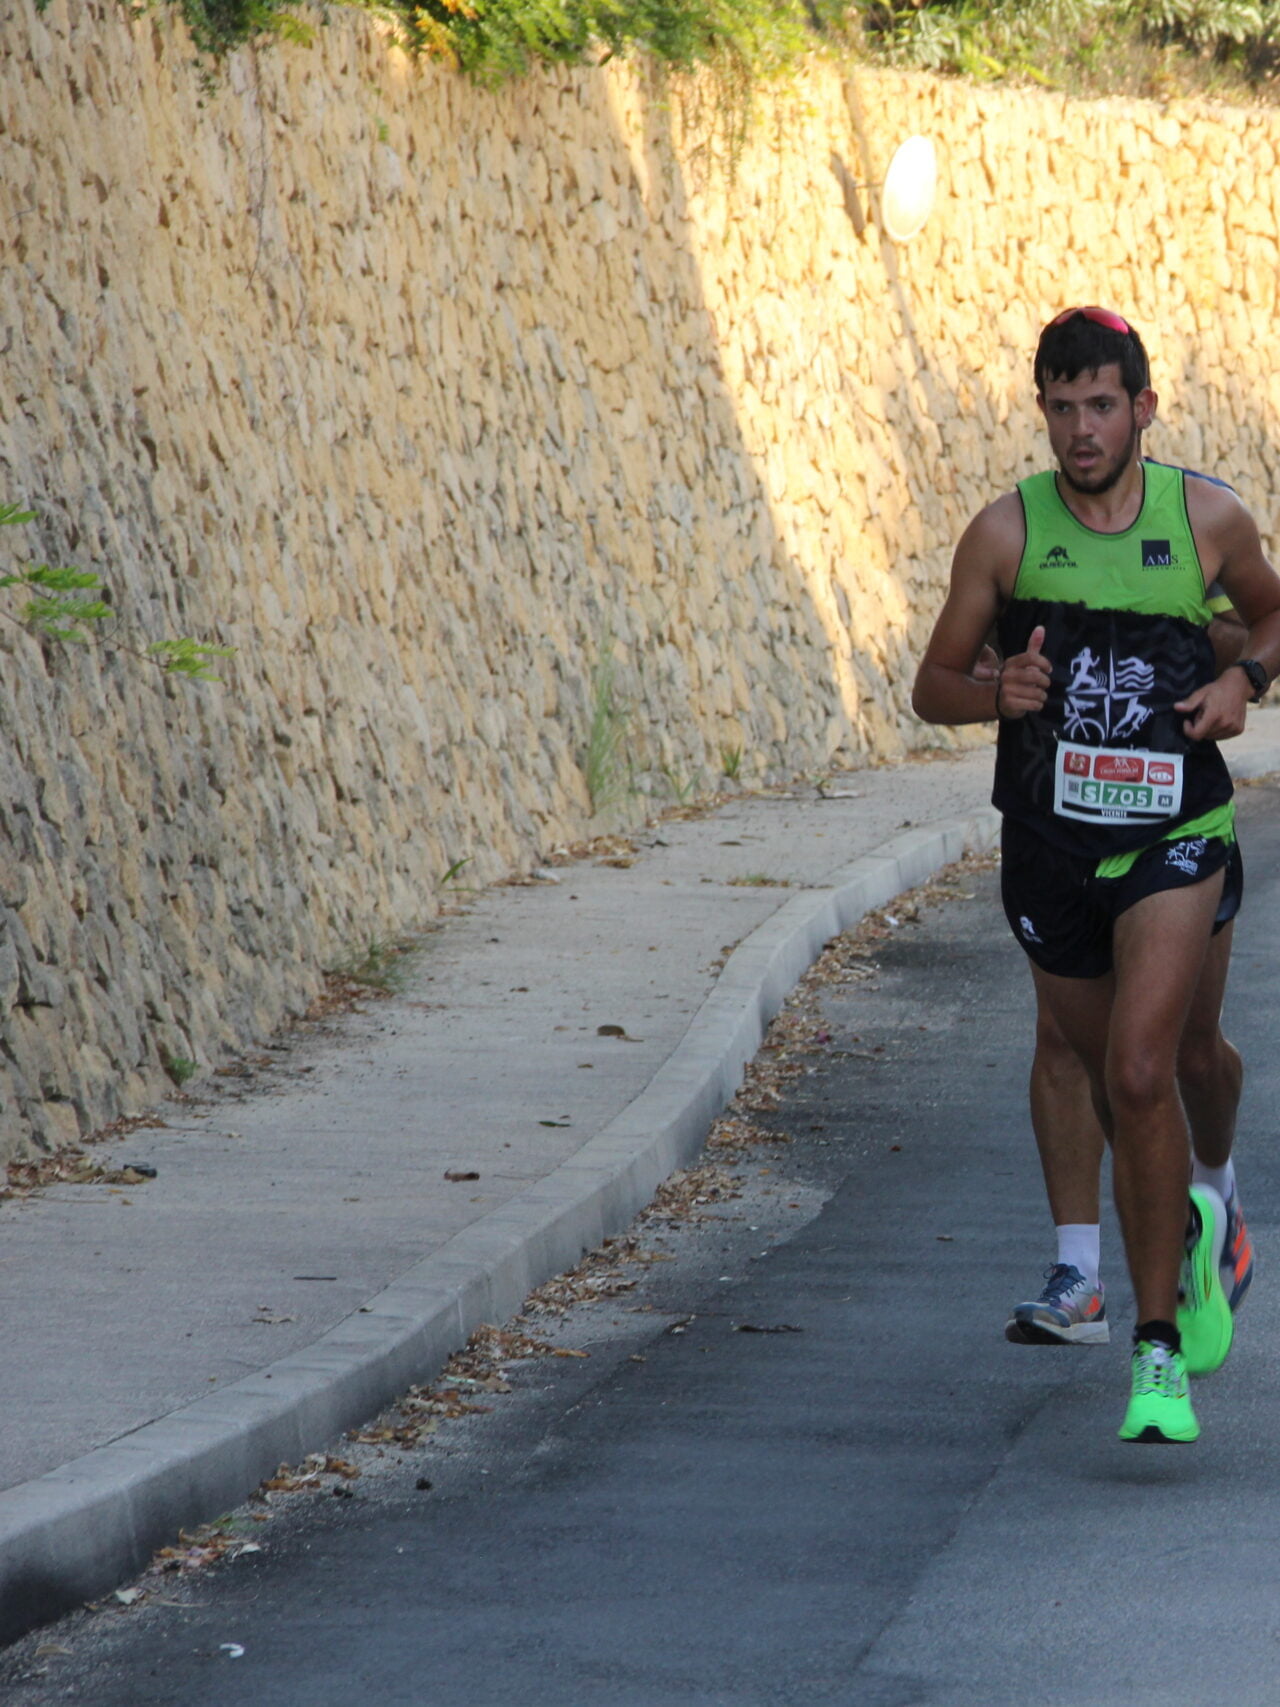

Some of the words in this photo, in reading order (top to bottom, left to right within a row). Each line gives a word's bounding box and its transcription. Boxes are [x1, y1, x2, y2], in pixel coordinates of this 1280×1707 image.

[1145, 554, 1179, 566] AMS
[1084, 786, 1097, 803] S
[1107, 788, 1149, 807] 705
